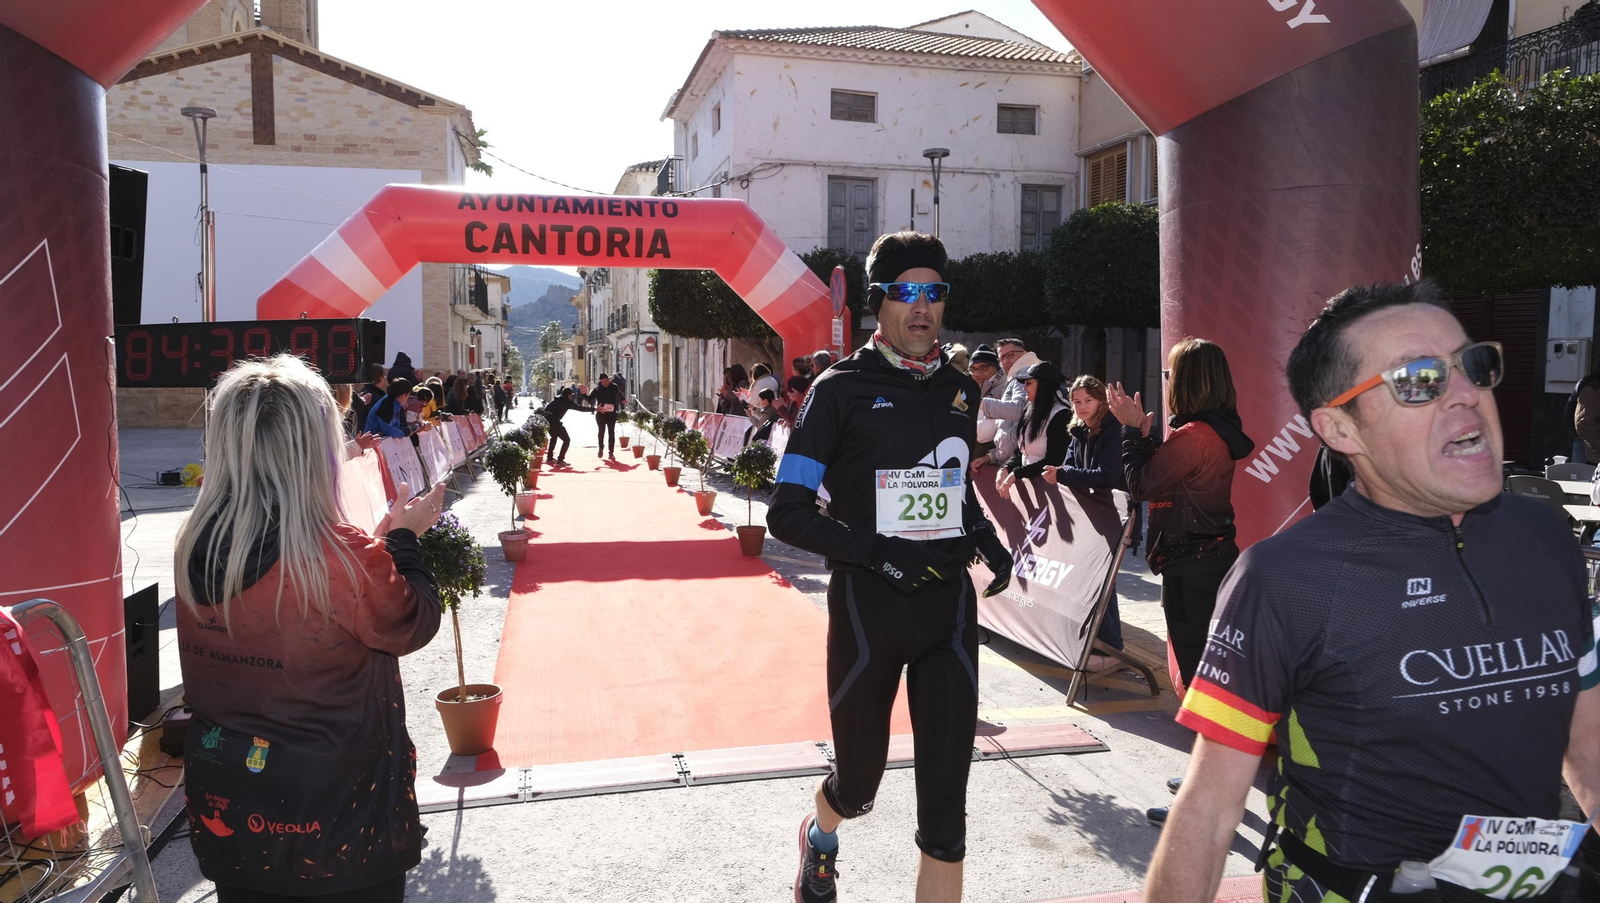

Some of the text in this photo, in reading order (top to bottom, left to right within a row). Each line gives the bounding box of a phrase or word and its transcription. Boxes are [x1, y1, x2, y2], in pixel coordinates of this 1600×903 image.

[458, 193, 679, 218] AYUNTAMIENTO
[464, 220, 672, 259] CANTORIA
[872, 401, 894, 409] ATIKA
[887, 479, 939, 489] LA PÓLVORA
[890, 470, 925, 479] IV CxM
[898, 492, 948, 521] 239
[1401, 594, 1447, 609] INVERSE
[209, 650, 284, 670] ALMANZORA
[1400, 629, 1575, 686] CUELLAR
[1438, 681, 1571, 715] STONE 1958
[267, 820, 322, 834] VEOLIA
[1486, 819, 1537, 835] IV CxM
[1474, 839, 1492, 854] LA
[1497, 838, 1560, 857] PÓLVORA
